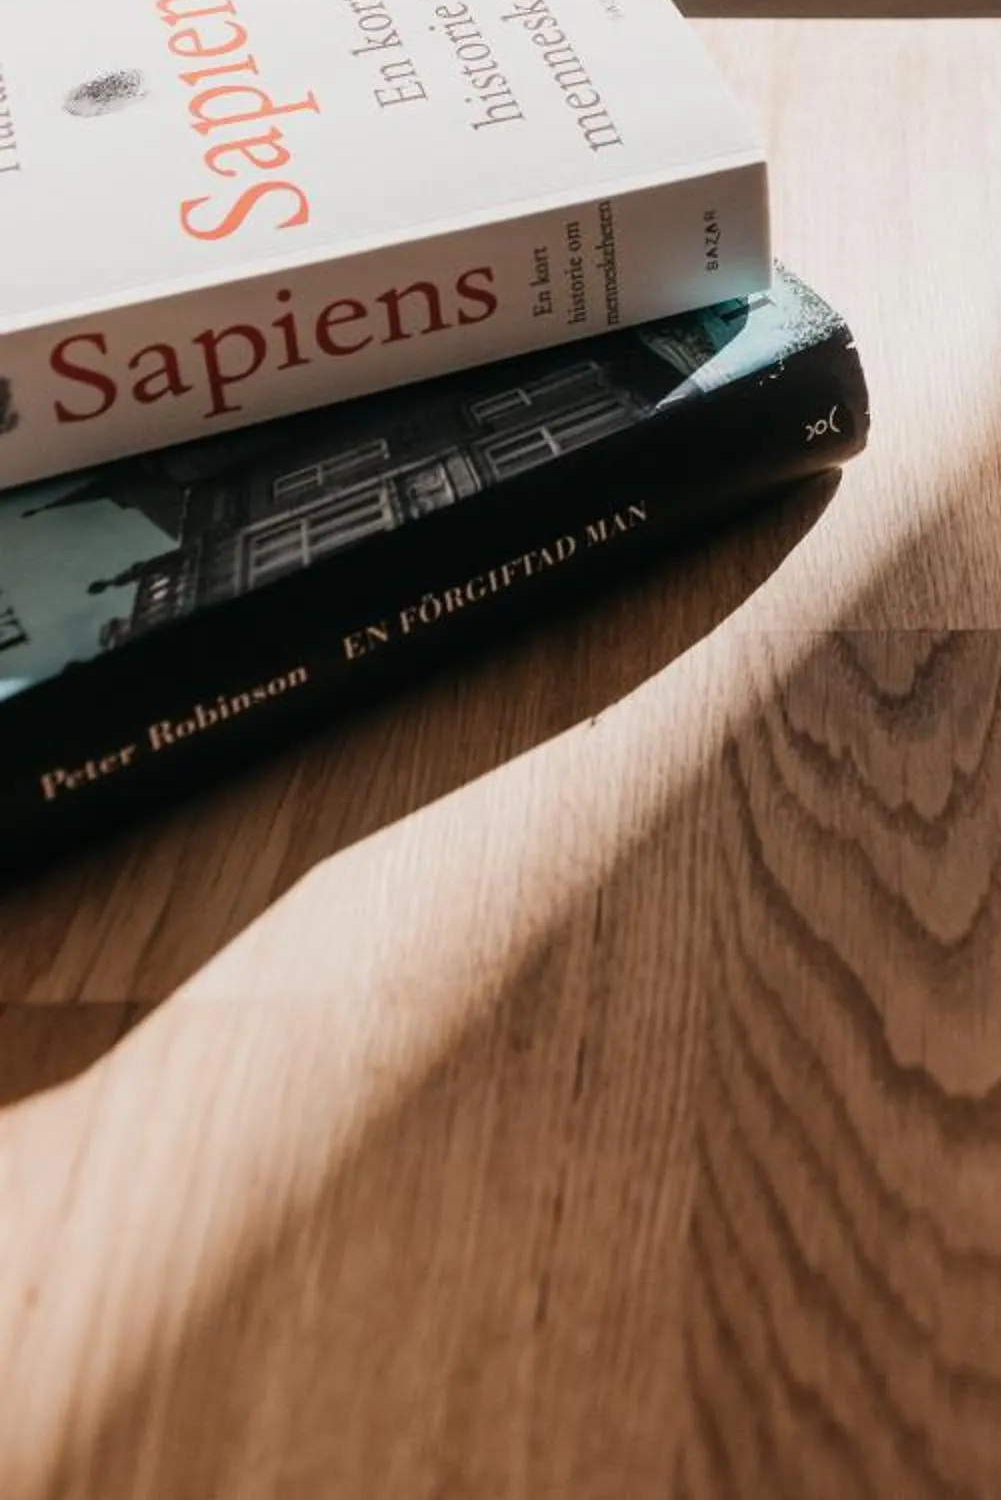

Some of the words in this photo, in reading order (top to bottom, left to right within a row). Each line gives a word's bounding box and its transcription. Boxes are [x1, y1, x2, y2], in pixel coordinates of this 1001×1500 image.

[374, 58, 428, 109] En
[429, 1, 525, 131] historie
[530, 245, 548, 288] kort
[566, 220, 582, 253] om
[595, 200, 620, 326] menneskeheten
[704, 208, 721, 272] BAZAR
[533, 290, 552, 318] En
[565, 254, 587, 325] historie
[49, 265, 498, 424] Sapiens
[341, 620, 390, 660] EN
[399, 534, 577, 636] FÖRGIFTAD
[584, 499, 649, 549] MAN
[39, 743, 137, 801] Peter
[147, 665, 310, 752] Robinson
